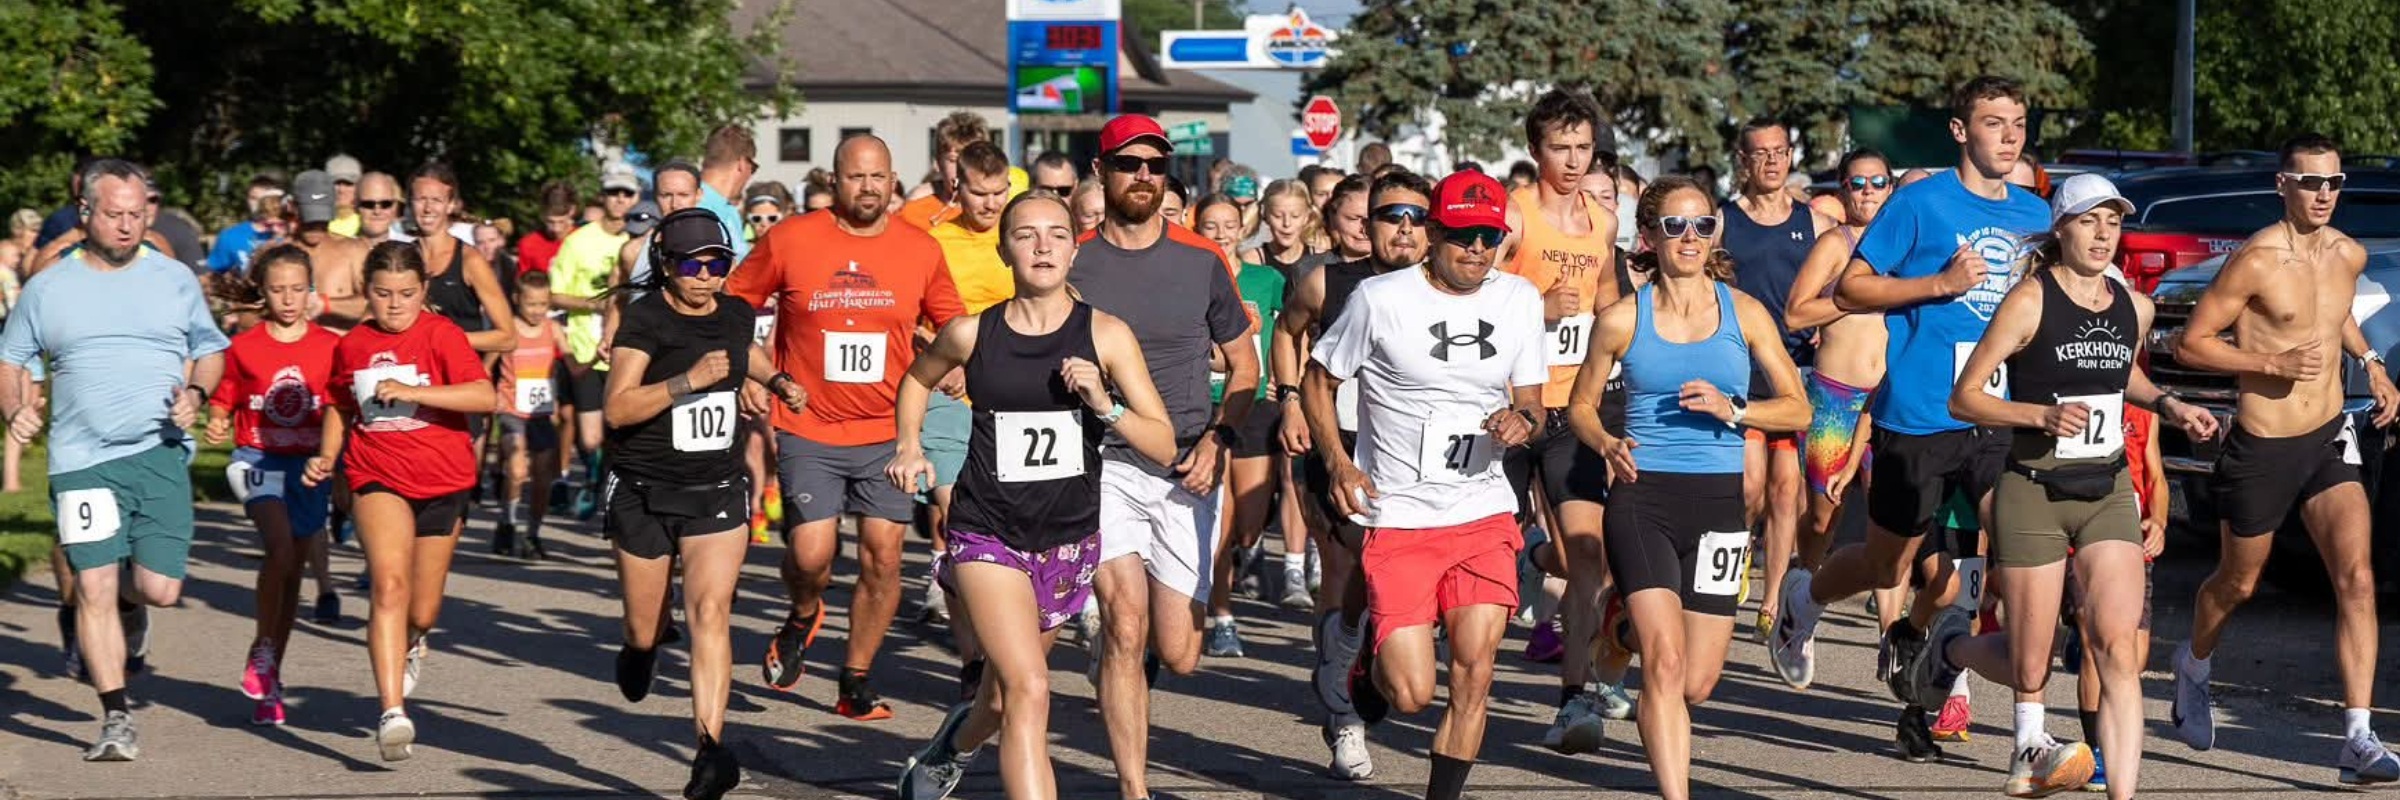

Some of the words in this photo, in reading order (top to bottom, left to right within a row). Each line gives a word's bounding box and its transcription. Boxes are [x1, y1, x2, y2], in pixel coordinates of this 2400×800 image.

[1304, 113, 1339, 133] STOP
[1542, 249, 1569, 264] NEW
[1571, 253, 1598, 268] YORK
[1560, 264, 1586, 278] CITY
[808, 300, 836, 312] HALF
[840, 298, 895, 309] MARATHON
[1978, 302, 1996, 312] 202
[1558, 325, 1580, 355] 91
[2055, 341, 2132, 363] KERKHOVEN
[840, 344, 872, 372] 118
[2077, 359, 2097, 369] RUN
[2099, 359, 2124, 369] CREW
[688, 405, 726, 439] 102
[2084, 409, 2105, 445] 12
[1023, 427, 1058, 467] 22
[1445, 434, 1476, 470] 27
[79, 501, 92, 530] 9
[1970, 569, 1980, 599] 8
